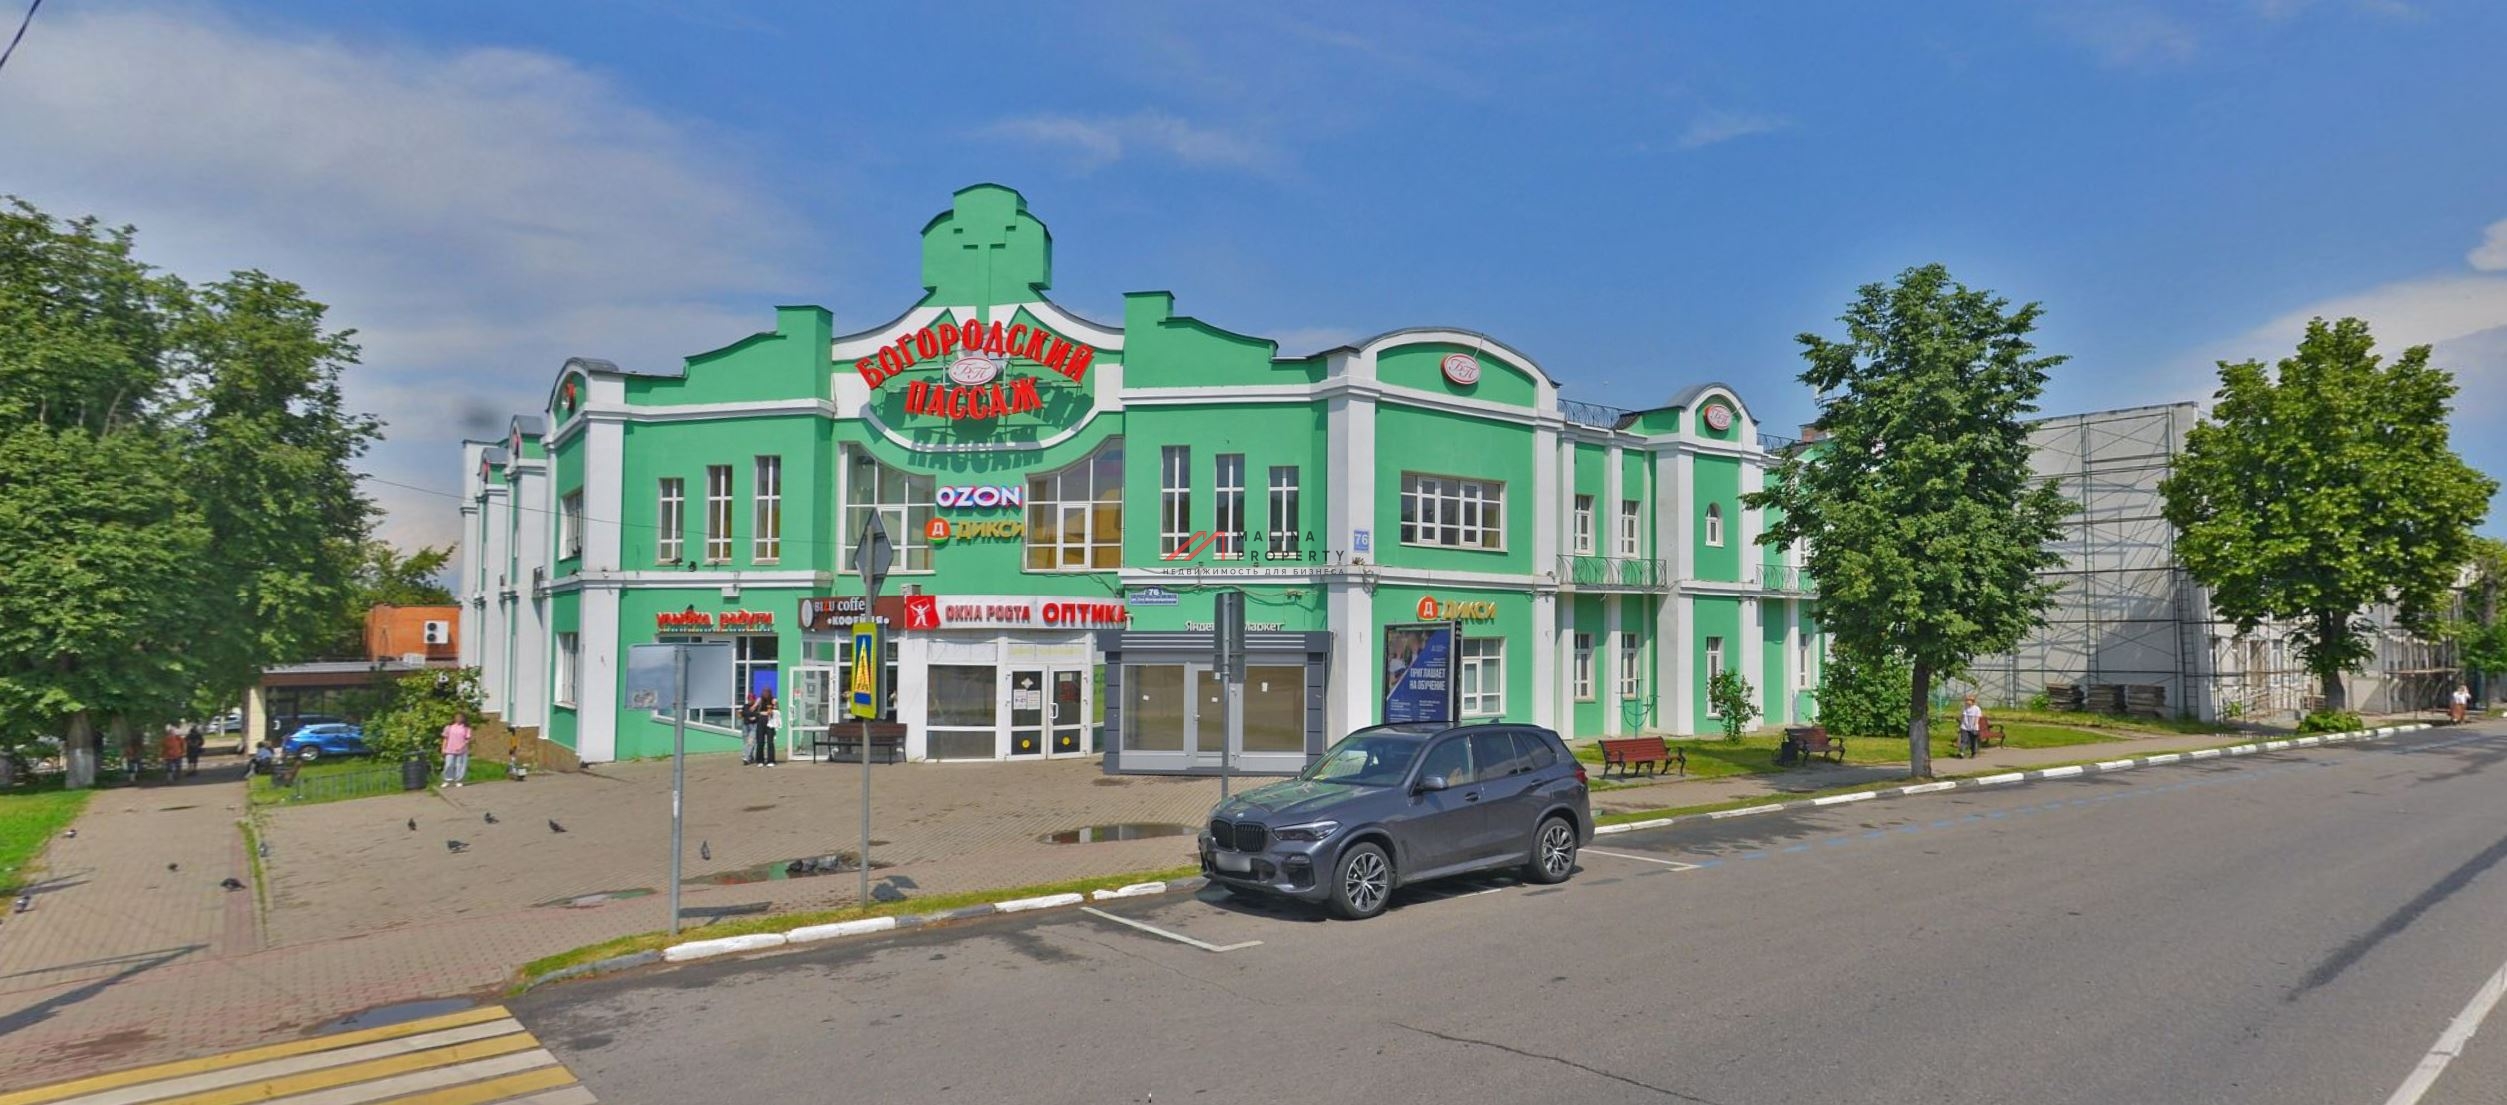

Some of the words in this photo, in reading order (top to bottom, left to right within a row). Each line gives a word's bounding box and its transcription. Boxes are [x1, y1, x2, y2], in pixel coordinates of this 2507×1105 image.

[855, 319, 1095, 390] БОГОРОДСКИЙ
[904, 377, 1044, 420] ПАССАЖ
[936, 485, 1022, 508] OZON
[957, 520, 1025, 539] ДИКСИ
[1355, 533, 1368, 546] 76
[945, 605, 983, 622] ОКНА
[986, 605, 1031, 623] РОСТА
[1042, 603, 1126, 623] ОПТИКА
[1442, 600, 1497, 620] ДИКСИ
[1185, 620, 1214, 632] Янде
[1410, 667, 1446, 678] ПРИГЛАШАЕТ
[1409, 680, 1417, 690] НА
[1418, 680, 1446, 691] ОБУЧЕНИЕ
